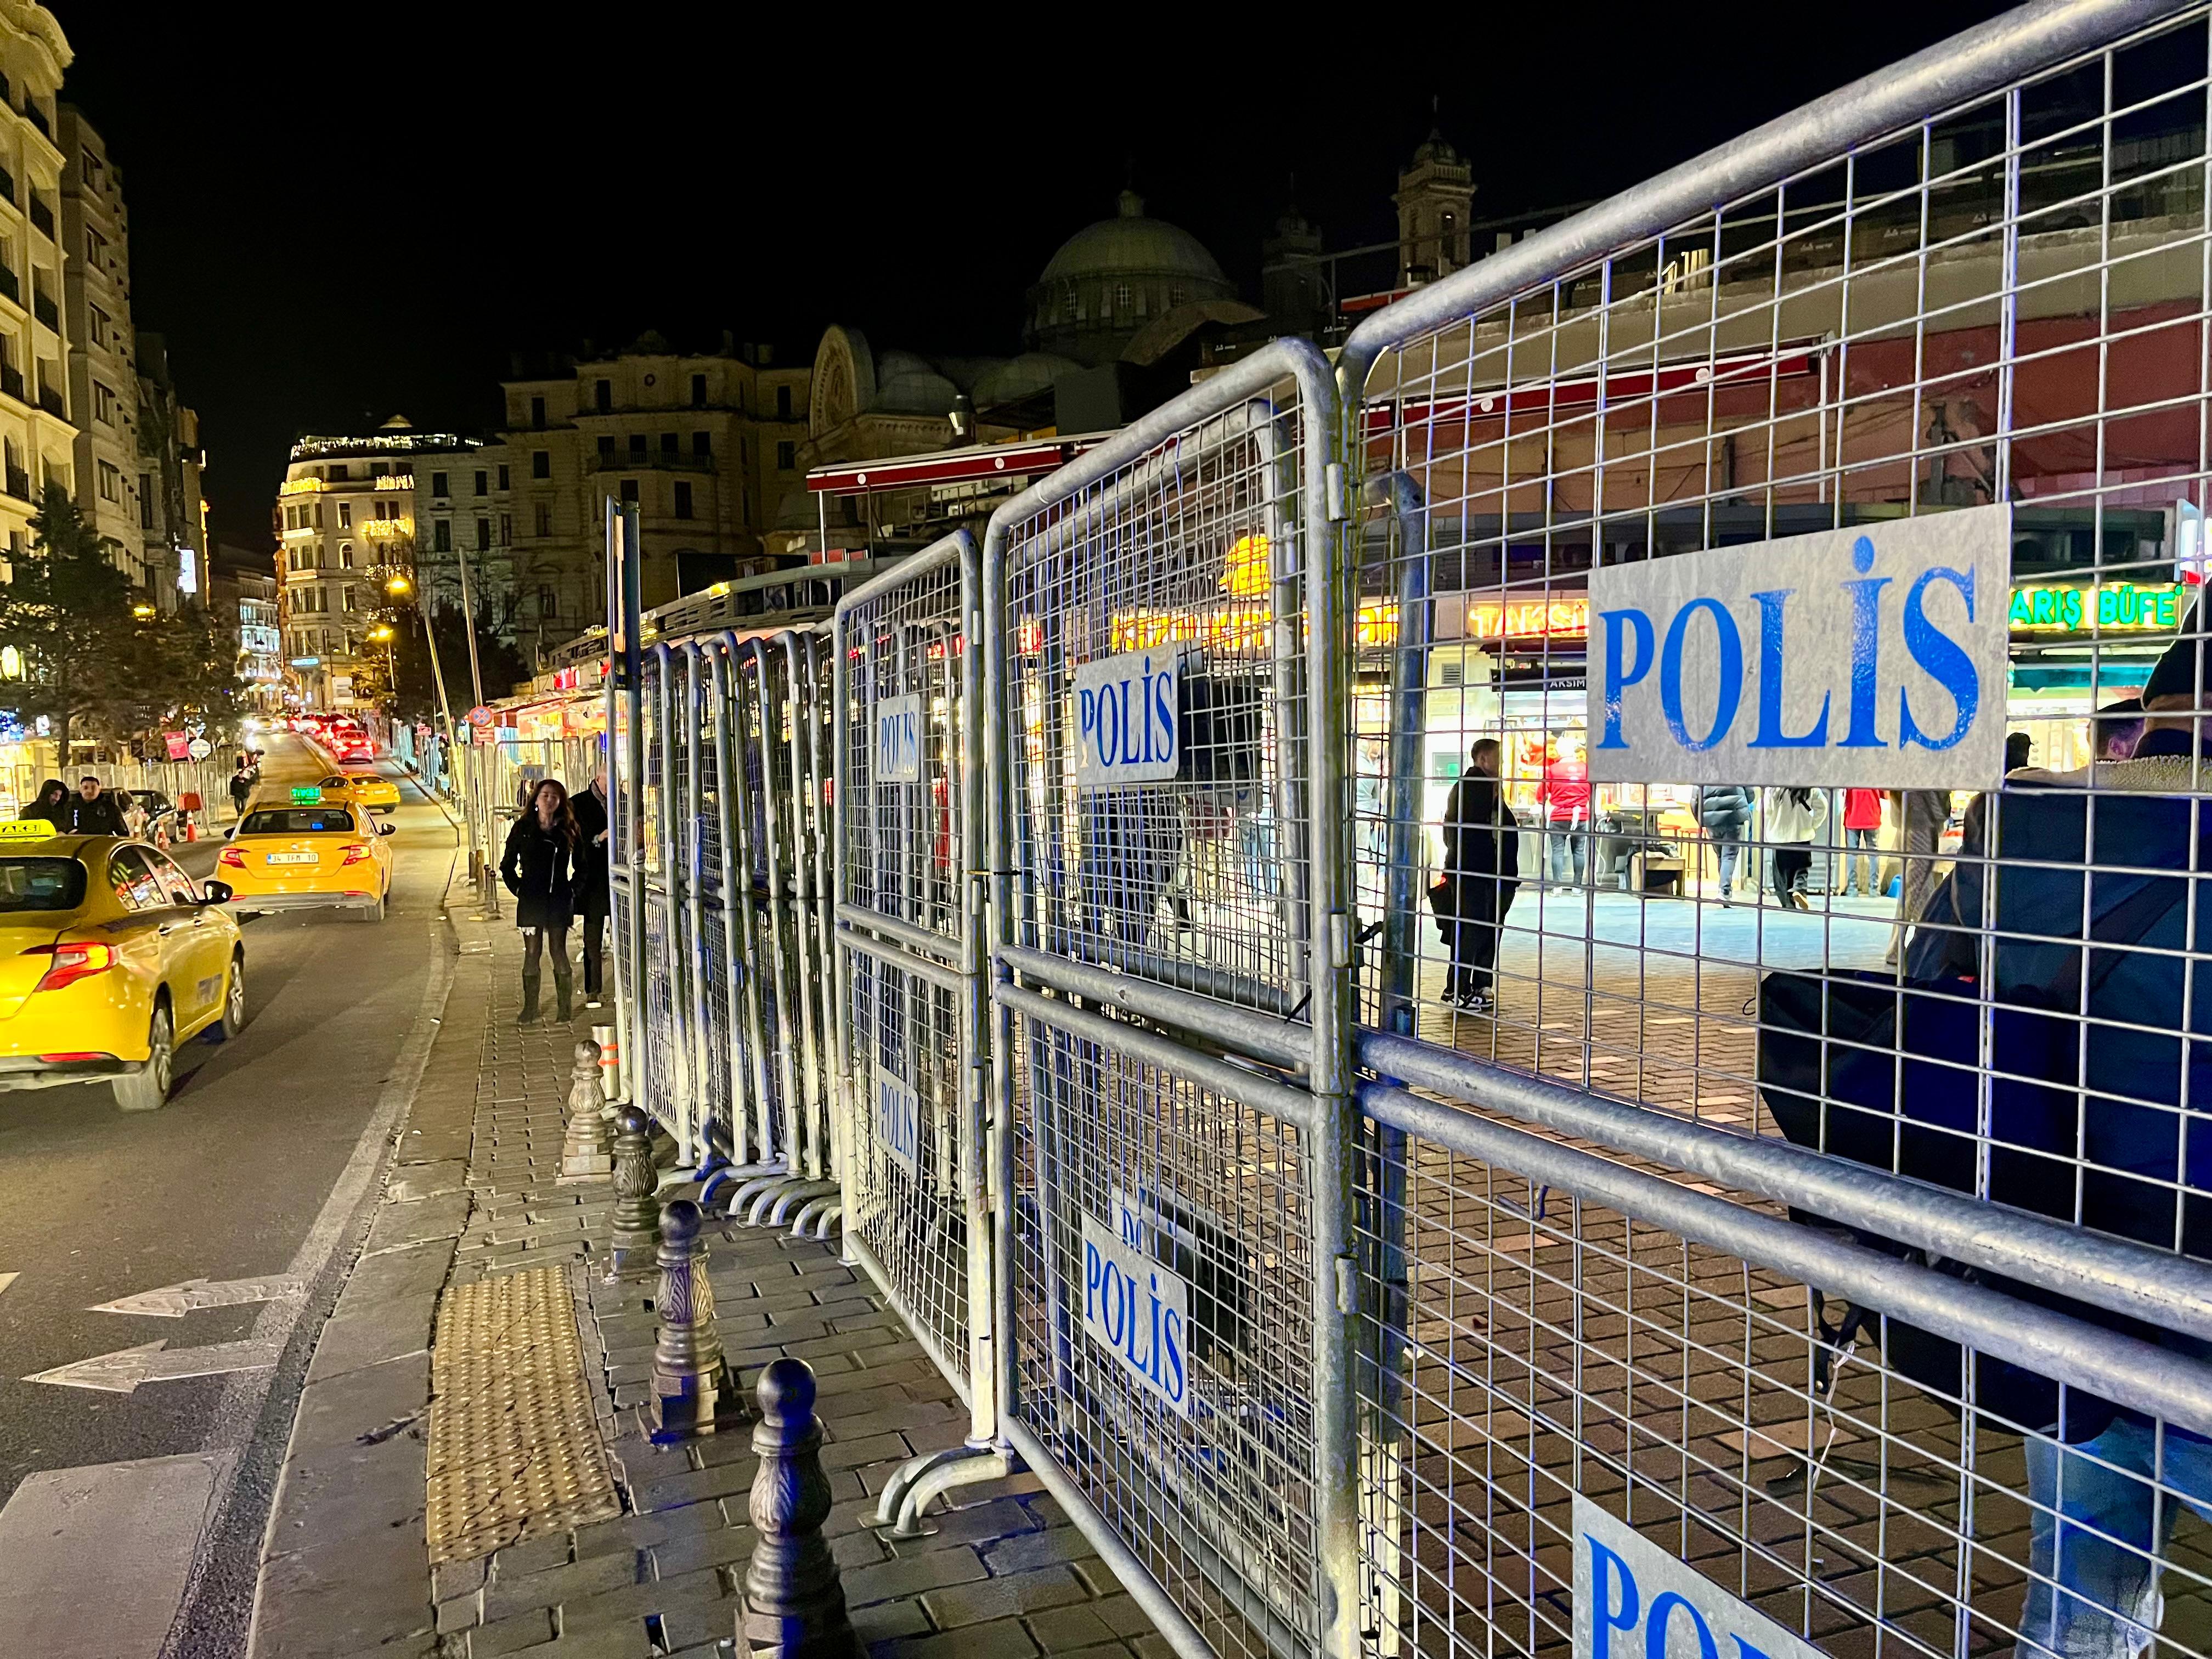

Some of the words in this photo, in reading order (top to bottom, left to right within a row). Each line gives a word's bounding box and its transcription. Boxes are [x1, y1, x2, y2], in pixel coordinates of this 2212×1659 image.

[1596, 535, 1978, 752] POLİS
[2099, 585, 2176, 625] BÜFE
[881, 698, 916, 775] POLİS
[1079, 655, 1174, 768] POLİS
[881, 1081, 913, 1160] POLİS
[1085, 1238, 1183, 1403] POLİS
[1583, 1532, 1771, 1659] PO
